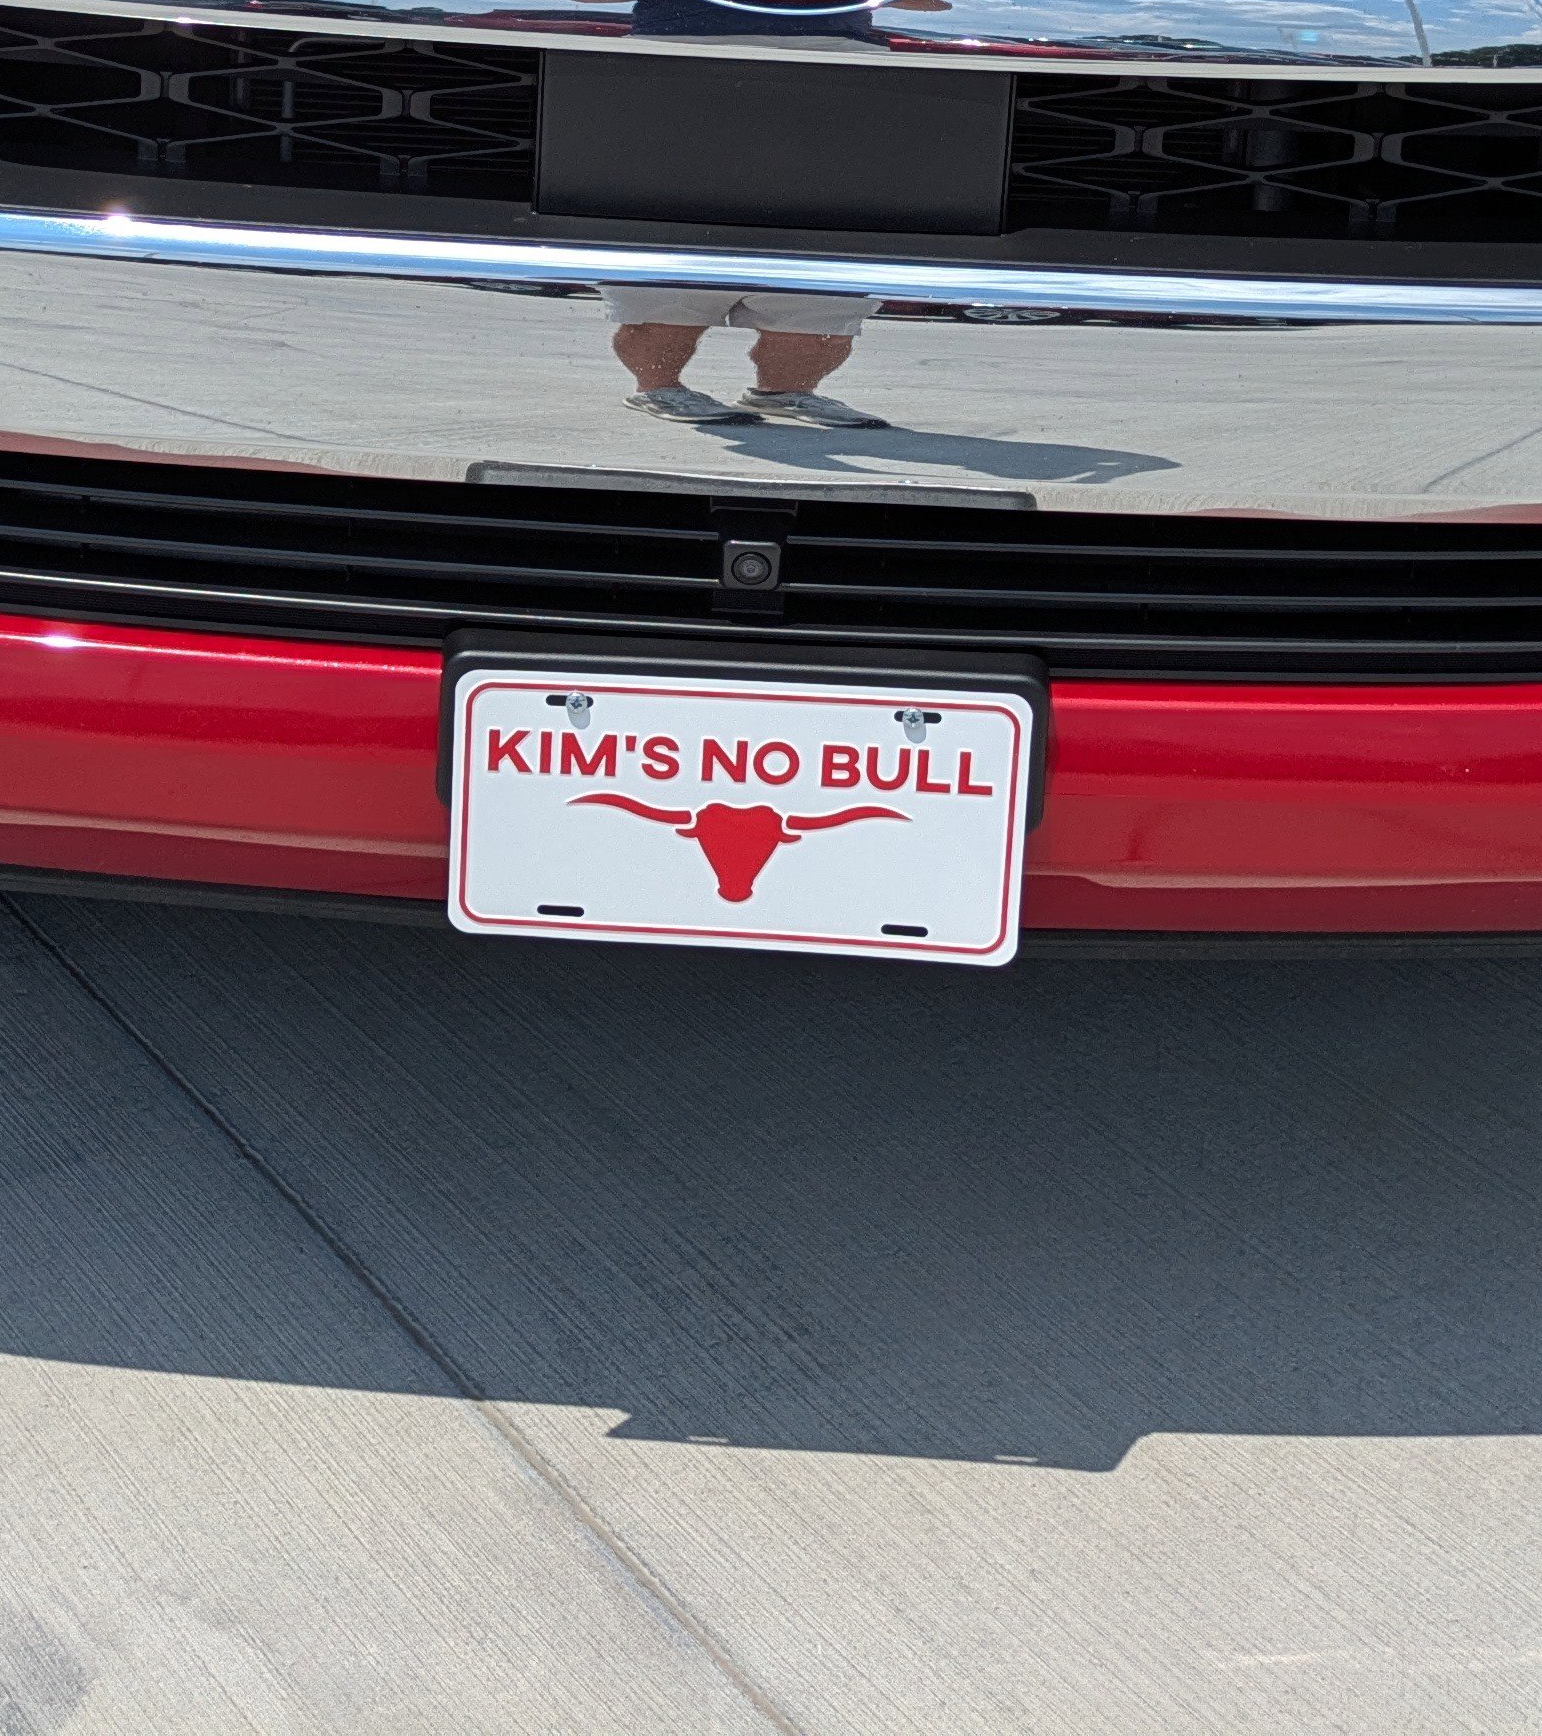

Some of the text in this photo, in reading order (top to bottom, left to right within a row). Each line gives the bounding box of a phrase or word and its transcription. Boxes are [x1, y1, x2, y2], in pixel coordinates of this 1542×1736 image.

[488, 729, 993, 796] KIM'S NO BULL
